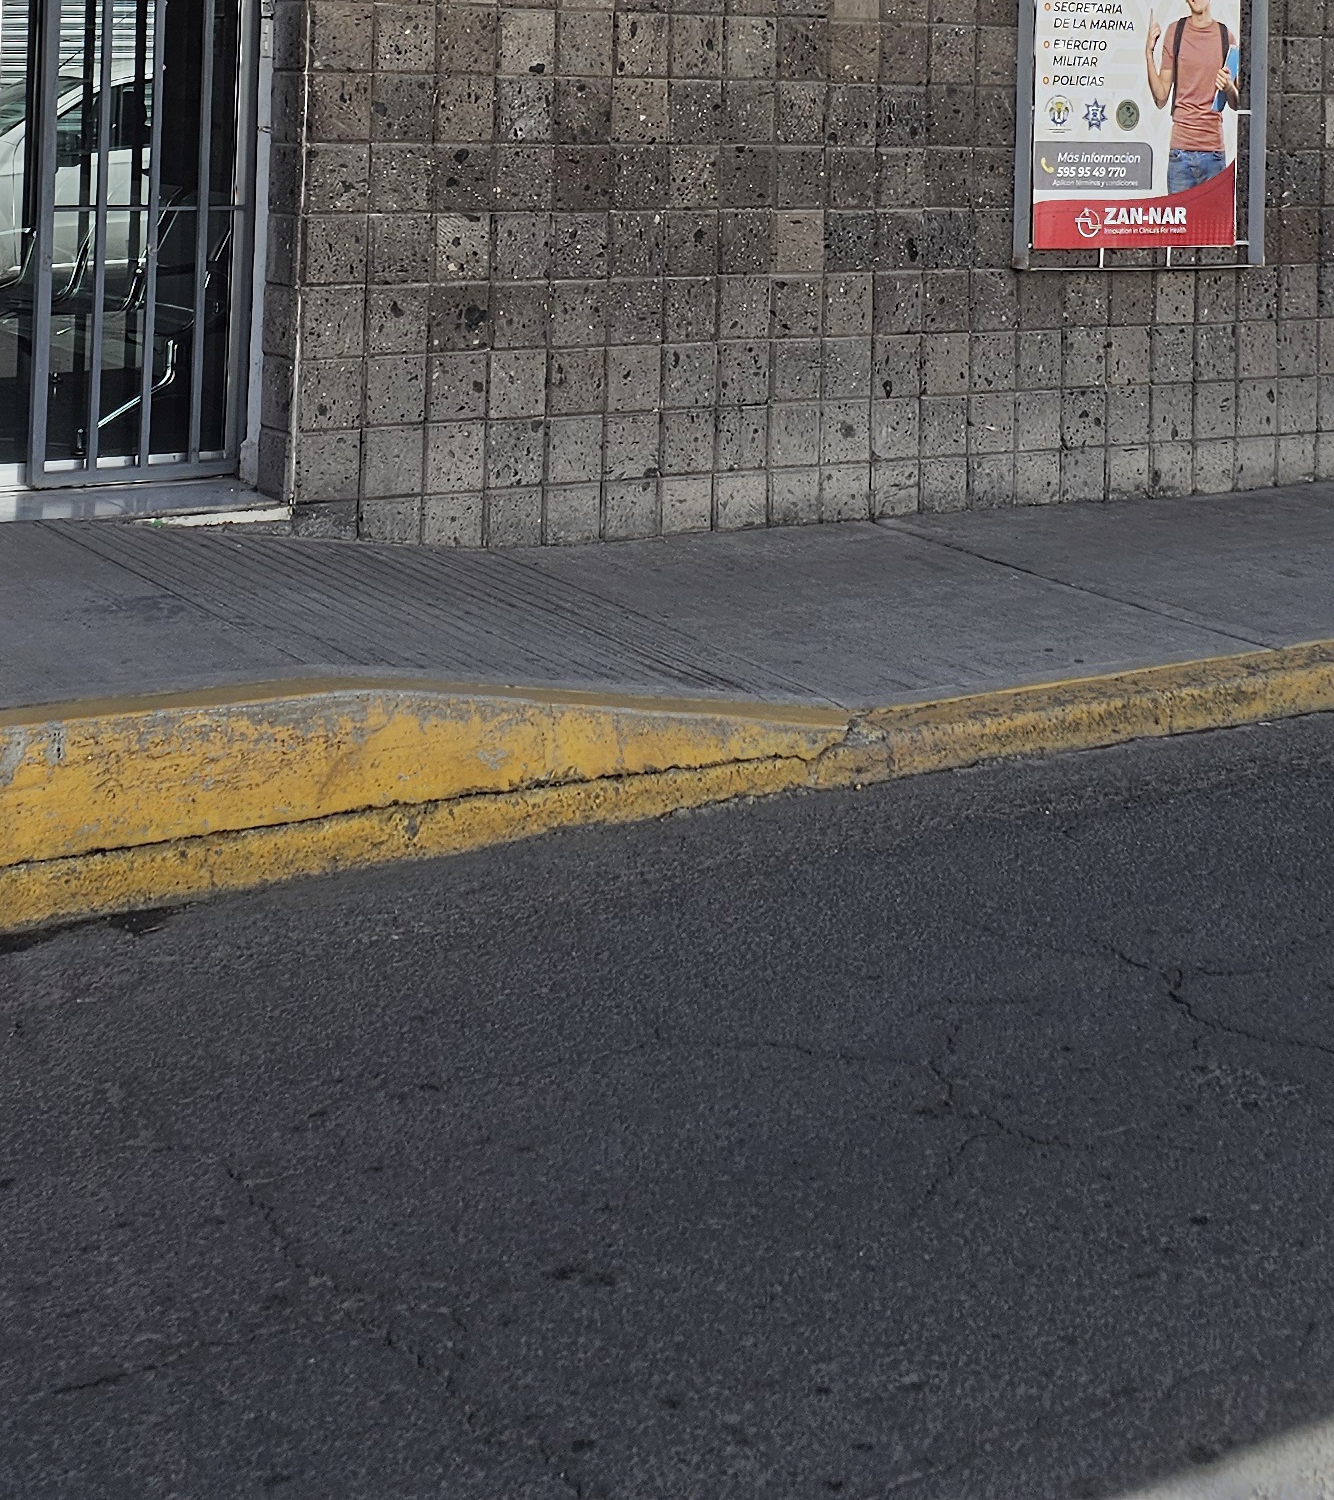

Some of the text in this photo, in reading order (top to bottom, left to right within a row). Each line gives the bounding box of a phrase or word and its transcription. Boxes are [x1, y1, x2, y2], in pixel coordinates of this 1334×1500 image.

[1053, 1, 1123, 14] SECRETARIA
[1053, 18, 1135, 31] DE LA MARINA
[1052, 55, 1098, 67] MILITAR
[1056, 167, 1126, 178] 595 95 49 770
[1103, 207, 1187, 225] ZAN-NAR
